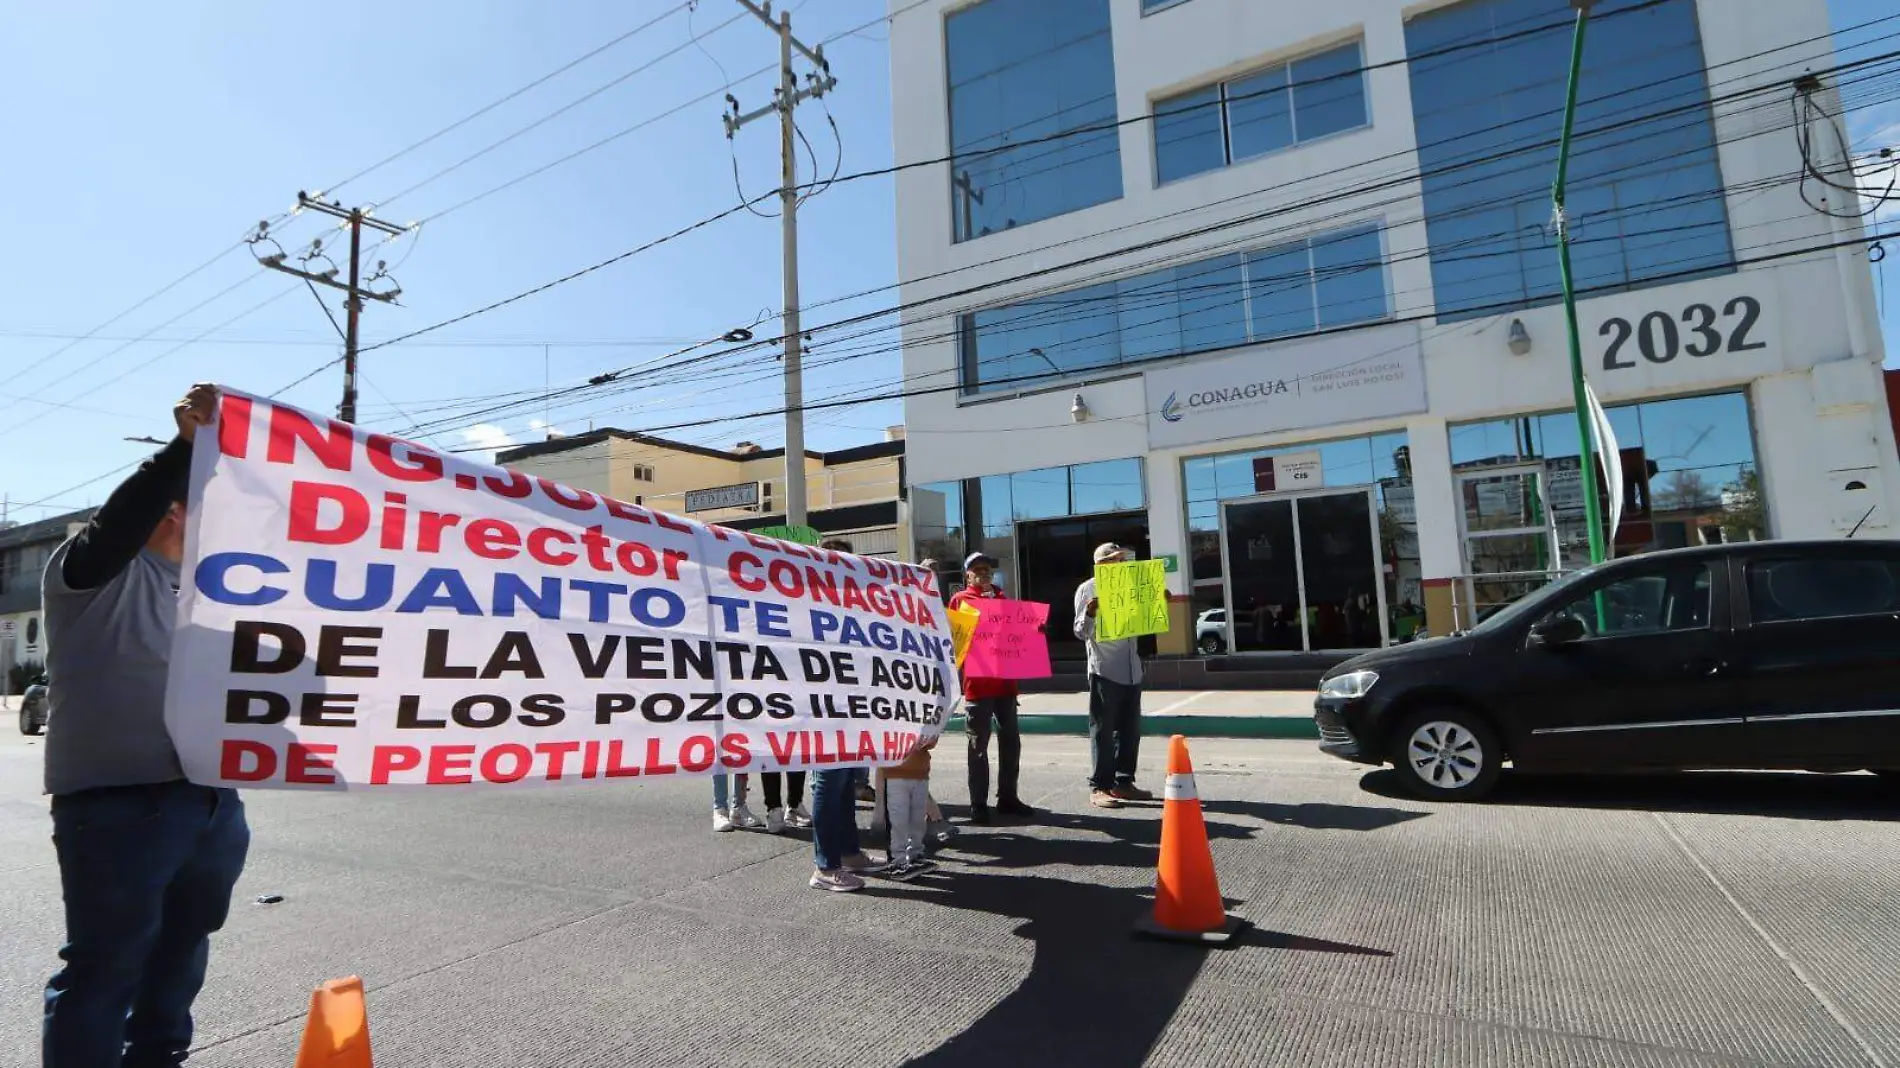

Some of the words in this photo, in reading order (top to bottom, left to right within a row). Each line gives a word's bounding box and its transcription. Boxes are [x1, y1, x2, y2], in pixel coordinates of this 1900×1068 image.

[1598, 296, 1766, 371] 2032
[1189, 380, 1288, 406] CONAGUA
[287, 480, 689, 581] Director
[728, 551, 938, 630] CONAGUA
[195, 552, 686, 627] CUANTO
[708, 595, 791, 638] TE
[810, 609, 955, 665] PAGAN?
[230, 620, 383, 678] DE
[423, 628, 545, 680] LA
[567, 633, 788, 681] VENTA
[799, 648, 859, 685] DE
[871, 656, 945, 698] AGUA
[225, 689, 359, 728] DE
[396, 693, 566, 729] LOS
[594, 692, 795, 725] POZOS
[809, 693, 944, 726] ILEGALES
[220, 739, 338, 785] DE
[370, 733, 752, 786] PEOTILLOS
[766, 730, 878, 766] VILLA
